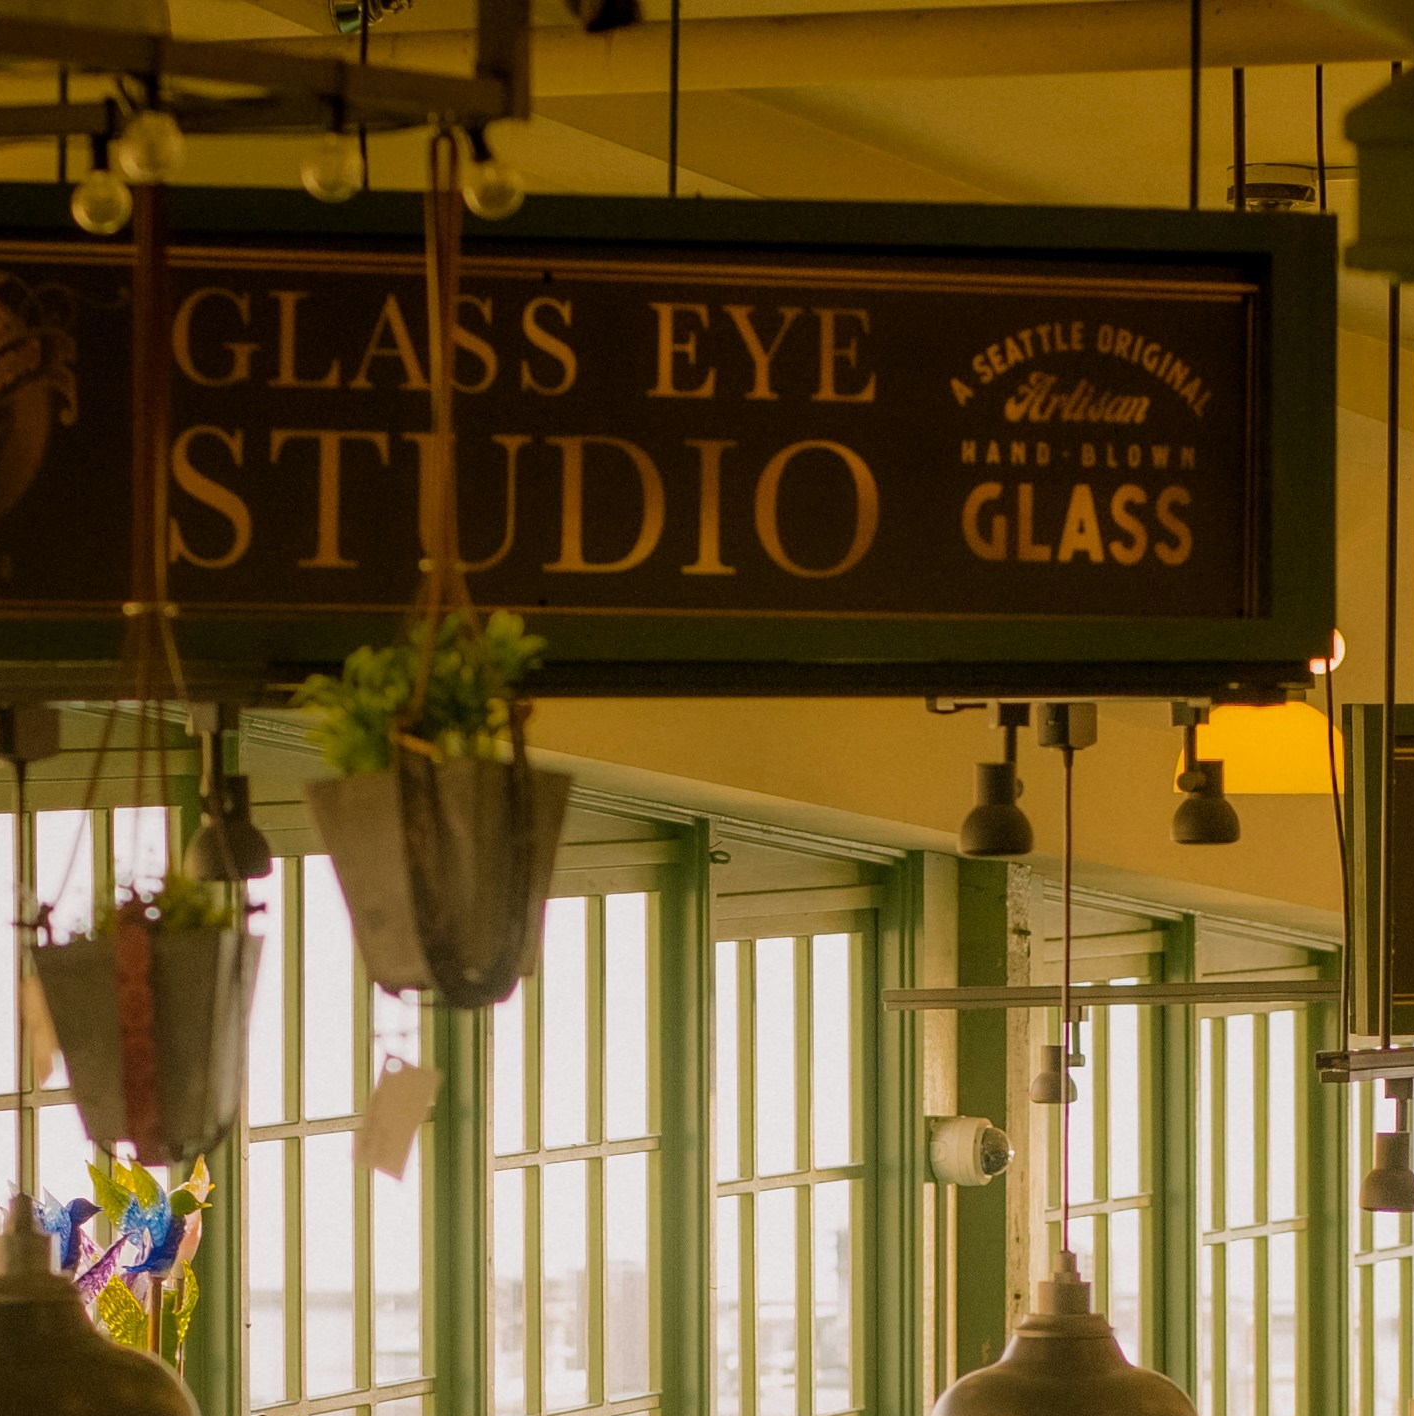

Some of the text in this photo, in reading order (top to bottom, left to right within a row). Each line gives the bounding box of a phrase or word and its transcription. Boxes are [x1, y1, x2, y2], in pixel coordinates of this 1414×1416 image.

[171, 286, 877, 402] GLASS EYE
[949, 320, 1213, 419] A SEATTLE ORIGINAL
[1003, 370, 1152, 425] Artisan
[168, 423, 879, 579] STUDIO
[961, 481, 1193, 566] GLASS
